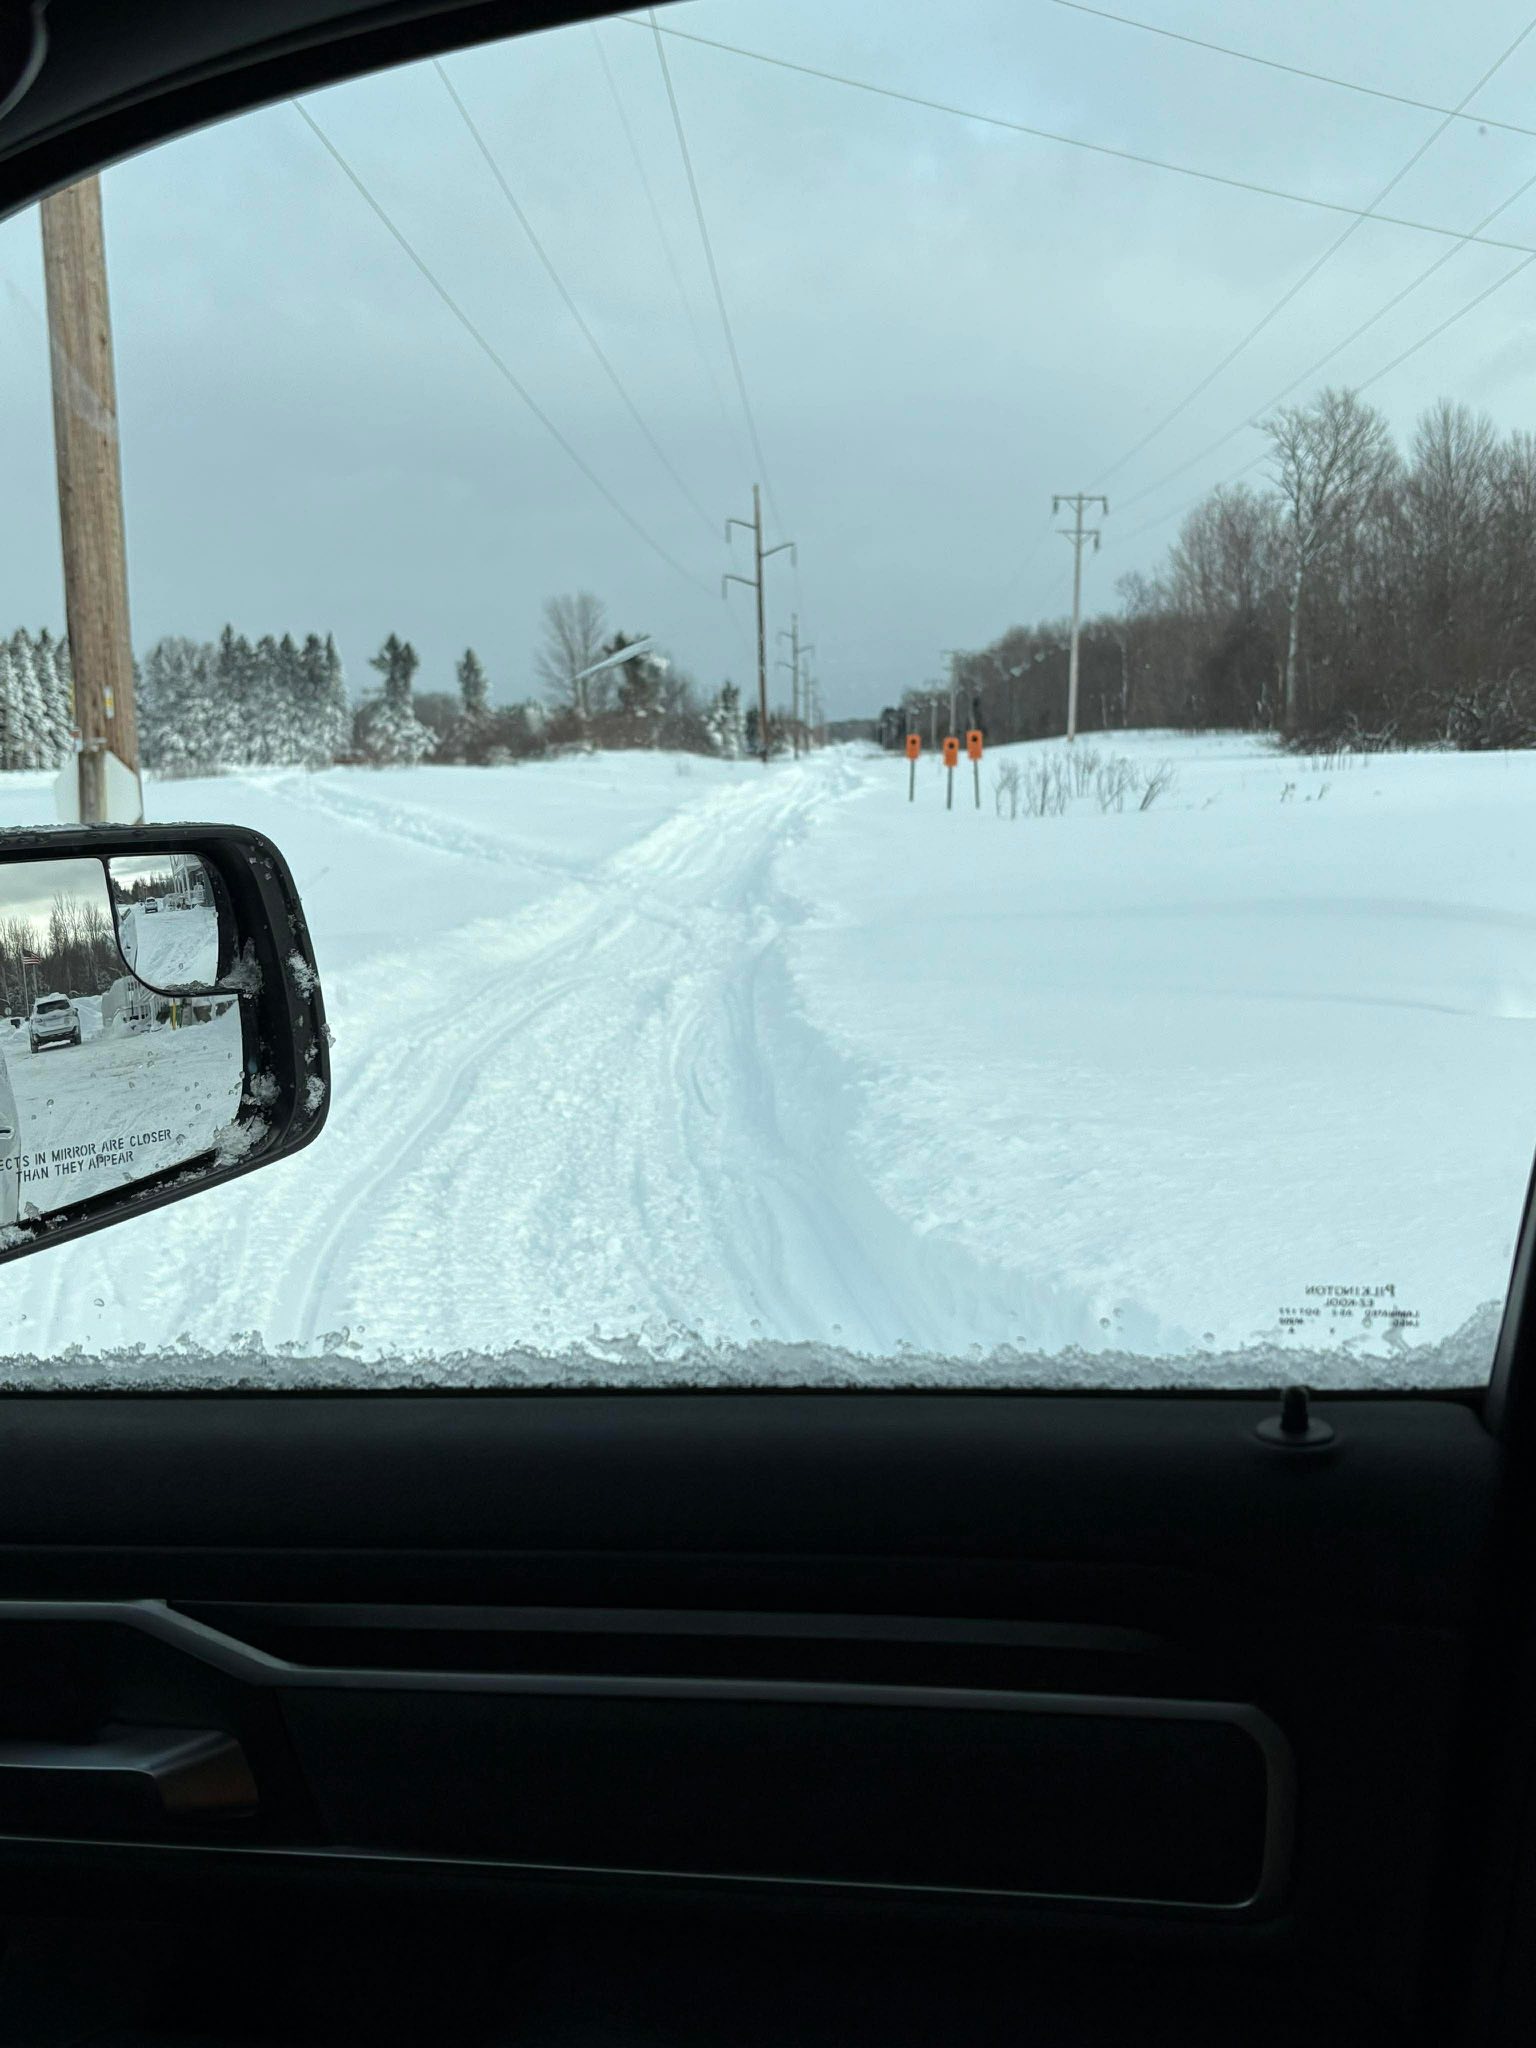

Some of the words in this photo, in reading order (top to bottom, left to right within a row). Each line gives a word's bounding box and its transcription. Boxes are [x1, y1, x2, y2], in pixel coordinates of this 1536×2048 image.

[34, 1152, 46, 1165] IN
[51, 1143, 96, 1162] MIRROR
[101, 1137, 124, 1152] ARE
[129, 1129, 172, 1147] CLOSER
[16, 1167, 49, 1183] THAN
[54, 1159, 84, 1176] THEY
[88, 1150, 134, 1170] APPEAR
